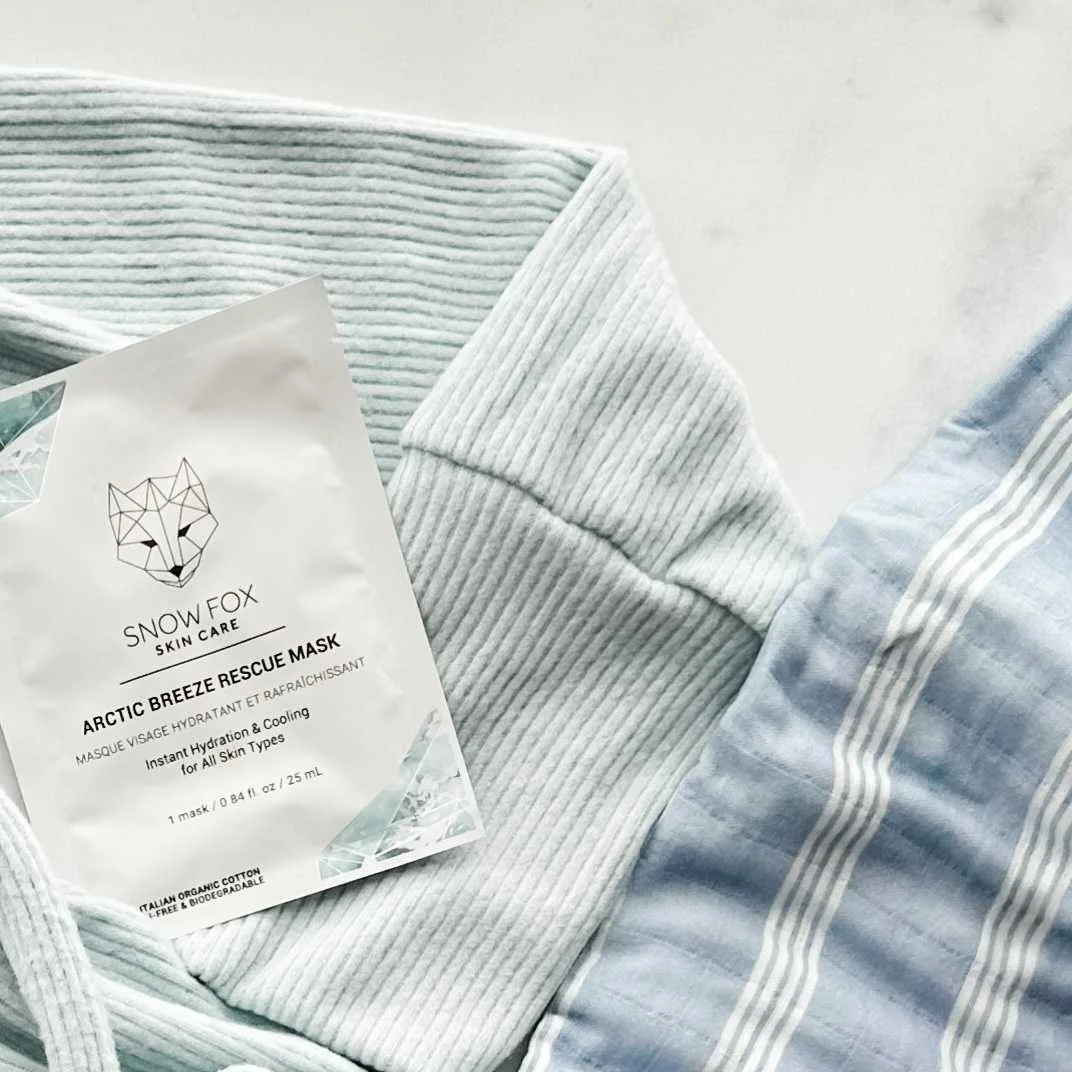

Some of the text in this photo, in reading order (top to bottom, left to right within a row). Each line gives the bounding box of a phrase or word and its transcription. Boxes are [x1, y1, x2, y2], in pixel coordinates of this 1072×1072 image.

[123, 584, 259, 647] SNOW FOX
[156, 619, 240, 656] SKIN CARE
[76, 656, 366, 766] MASQUE VISAGE HYDRATANT ET RAFRAÎCHISSANT
[83, 633, 340, 735] ARCTIC BREEZE RESCUE MASK
[145, 707, 310, 771] Instant Hydration & Cooling
[181, 732, 285, 776] for All Skin Types
[168, 816, 175, 825] 1
[178, 803, 209, 822] mask
[262, 782, 276, 794] oz
[287, 773, 302, 786] 25
[305, 766, 323, 782] mL
[178, 881, 220, 900] ORGANIC
[222, 867, 260, 886] COTTON
[181, 902, 187, 910] &
[190, 876, 264, 906] BIODEGRADABLE
